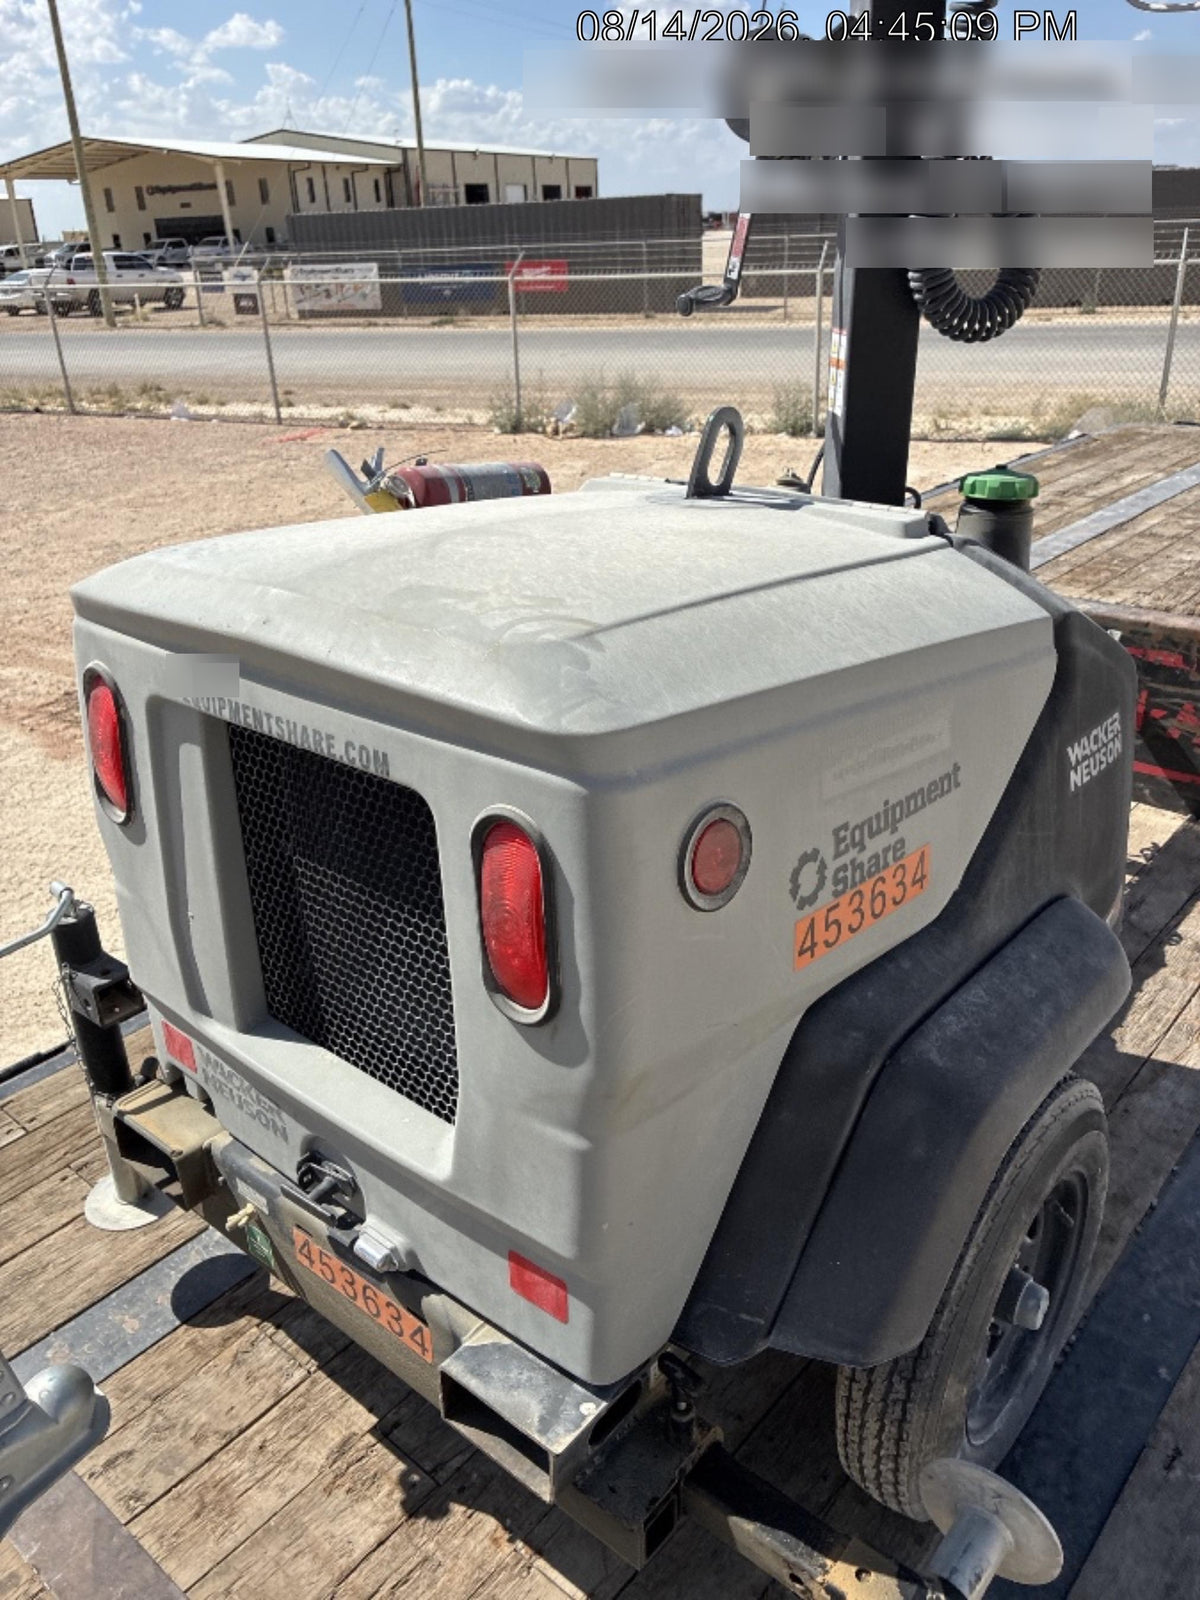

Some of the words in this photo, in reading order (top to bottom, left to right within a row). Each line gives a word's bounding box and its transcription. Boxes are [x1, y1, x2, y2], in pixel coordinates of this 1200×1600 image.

[182, 697, 390, 777] UIPMENTSHARE.COM
[1066, 712, 1121, 767] WACKER
[1070, 733, 1122, 792] NEUSON
[832, 762, 961, 861] Equipment
[797, 849, 928, 959] 453634
[832, 837, 906, 899] Share
[299, 1238, 429, 1358] 453634
